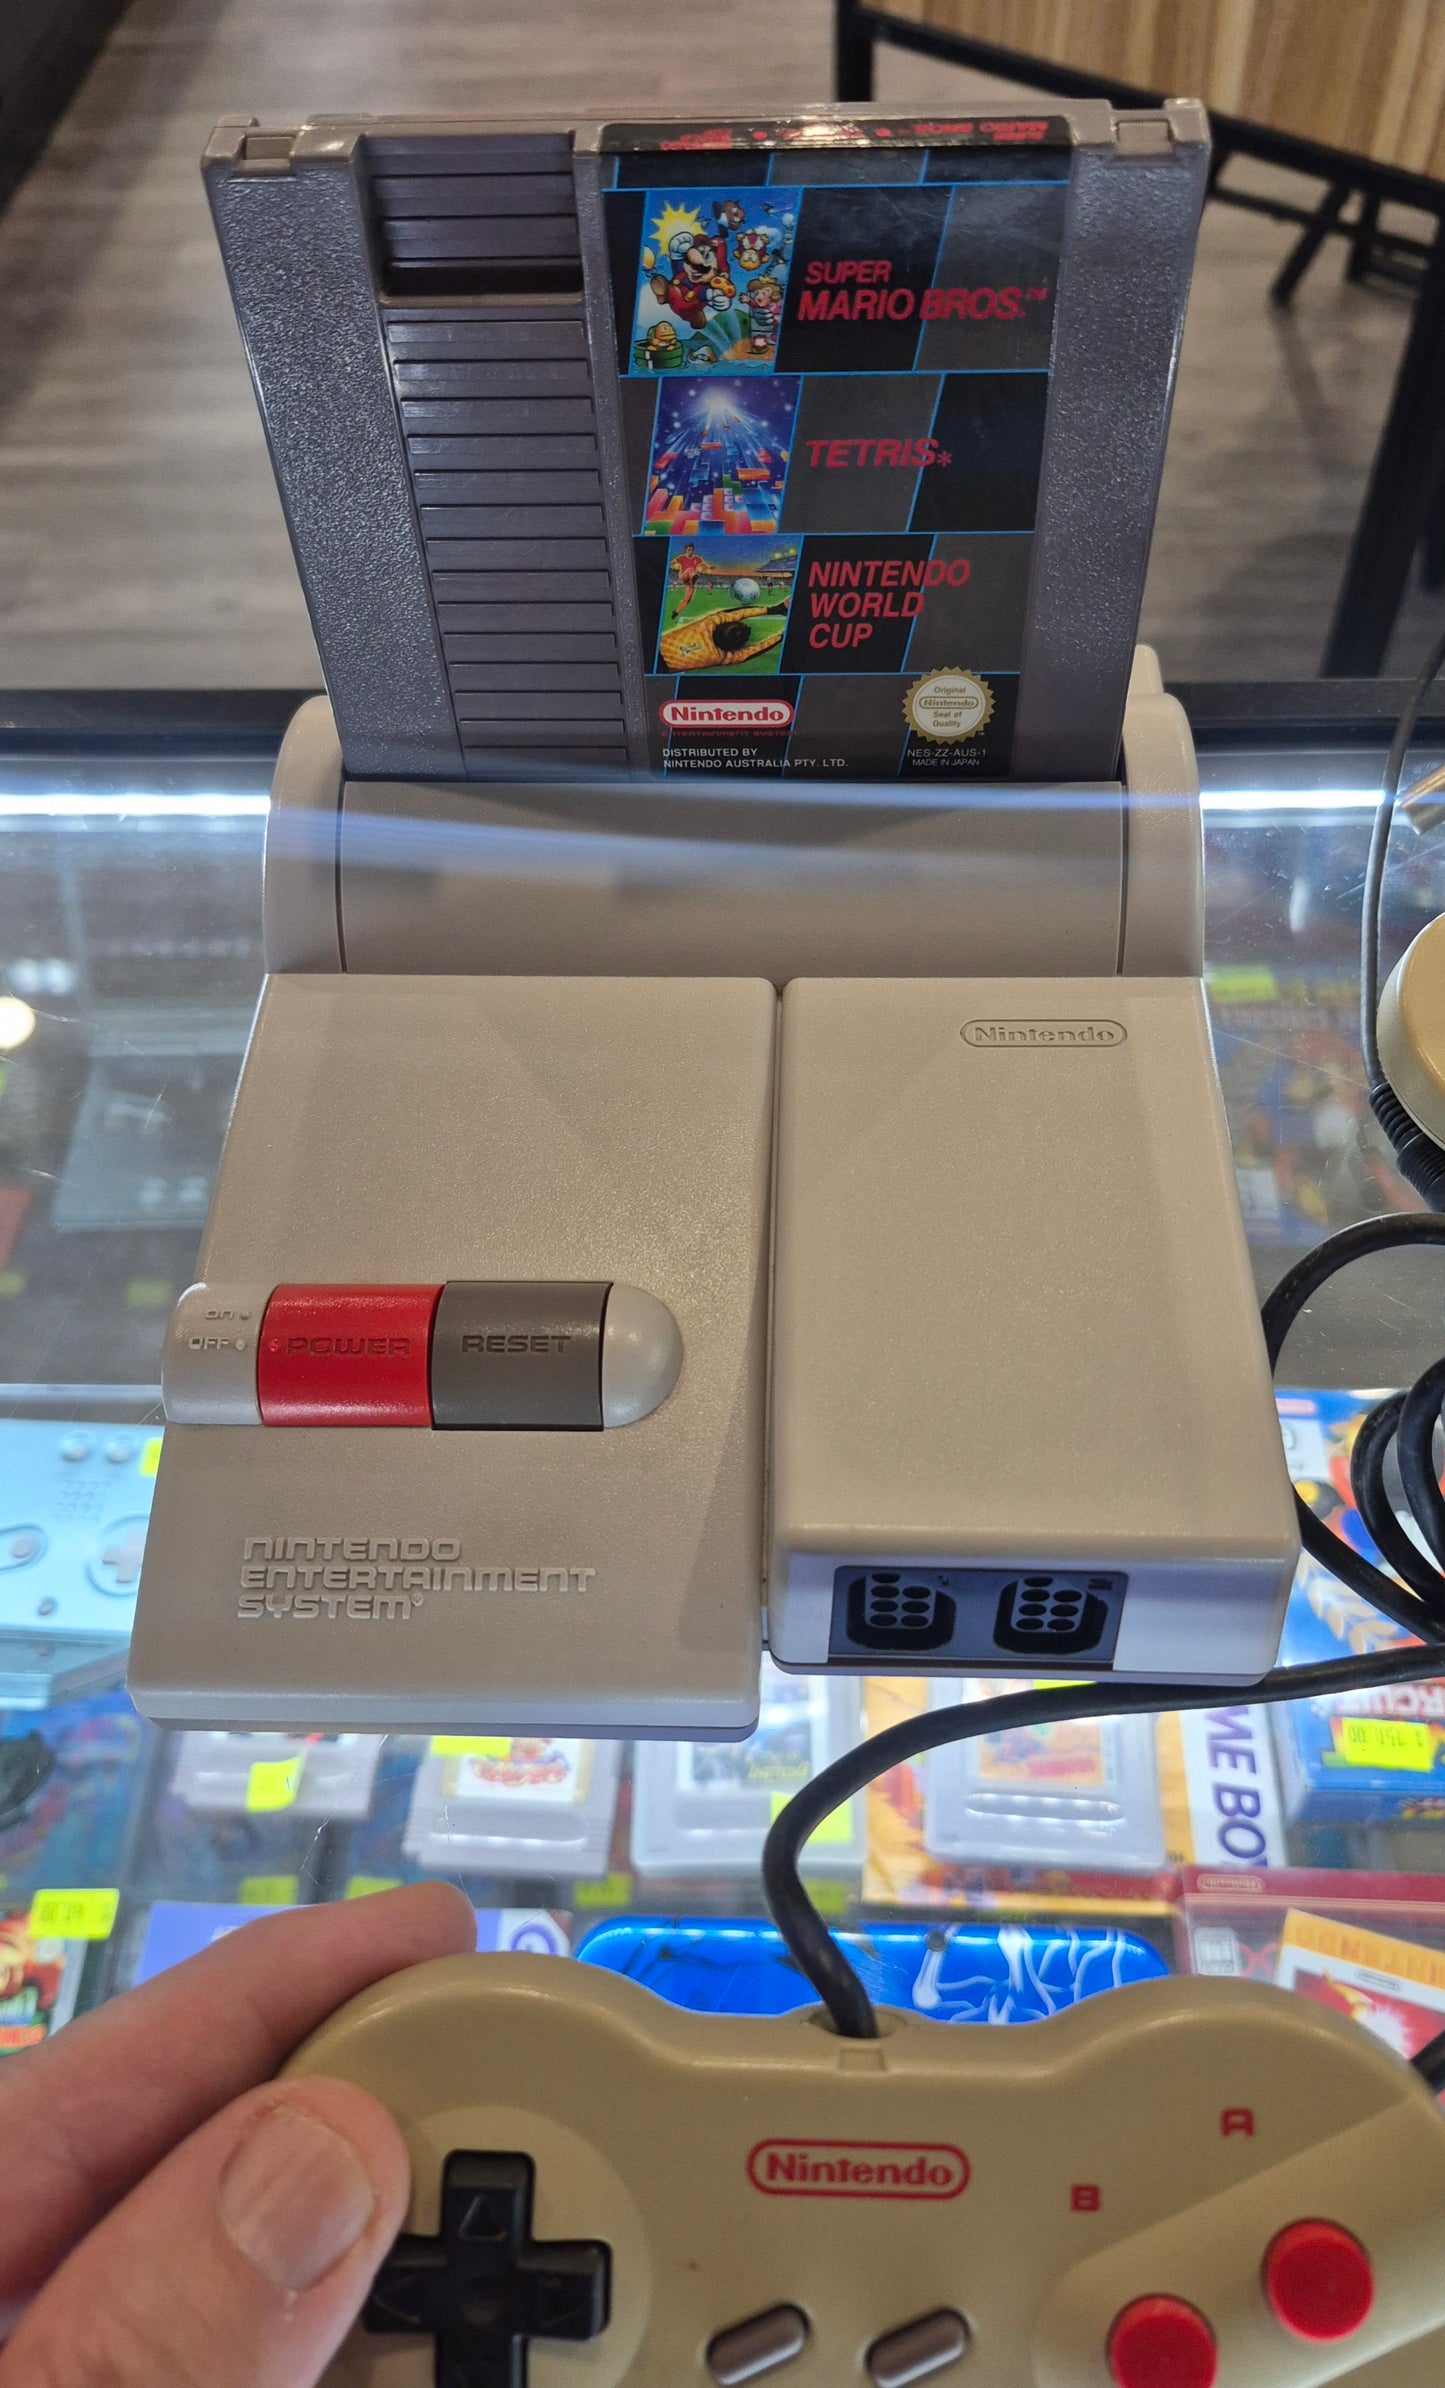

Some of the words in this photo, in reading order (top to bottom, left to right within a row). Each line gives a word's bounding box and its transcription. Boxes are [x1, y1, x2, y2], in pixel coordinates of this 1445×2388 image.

[805, 260, 892, 285] SUPER
[798, 288, 914, 321] MARIO
[807, 559, 971, 588] NINTENDO
[809, 592, 924, 619] WORLD
[808, 623, 873, 650] CUP
[933, 686, 966, 696] Original
[923, 699, 975, 707] Nintendo
[671, 706, 784, 722] Nintendo
[932, 720, 961, 728] Quality
[662, 748, 739, 757] DISTRIBUTED
[742, 748, 758, 757] BY
[907, 748, 986, 757] NES-ZZ-AUS-1
[663, 759, 722, 768] NINTENDO
[725, 759, 791, 768] AUSTRALIA
[794, 759, 819, 767] PTY.
[822, 758, 849, 767] LTD.
[974, 1026, 1115, 1042] Nintendo
[205, 1310, 233, 1320] ON
[188, 1336, 230, 1350] OFF
[287, 1337, 411, 1357] POWER
[461, 1335, 571, 1354] RESET
[244, 1537, 461, 1561] NINTENDO
[240, 1565, 596, 1592] ENTERTAINMENT
[1204, 1705, 1257, 1774] ME
[1221, 2107, 1255, 2138] A
[767, 2152, 952, 2186] Nintendo
[1070, 2184, 1100, 2213] B
